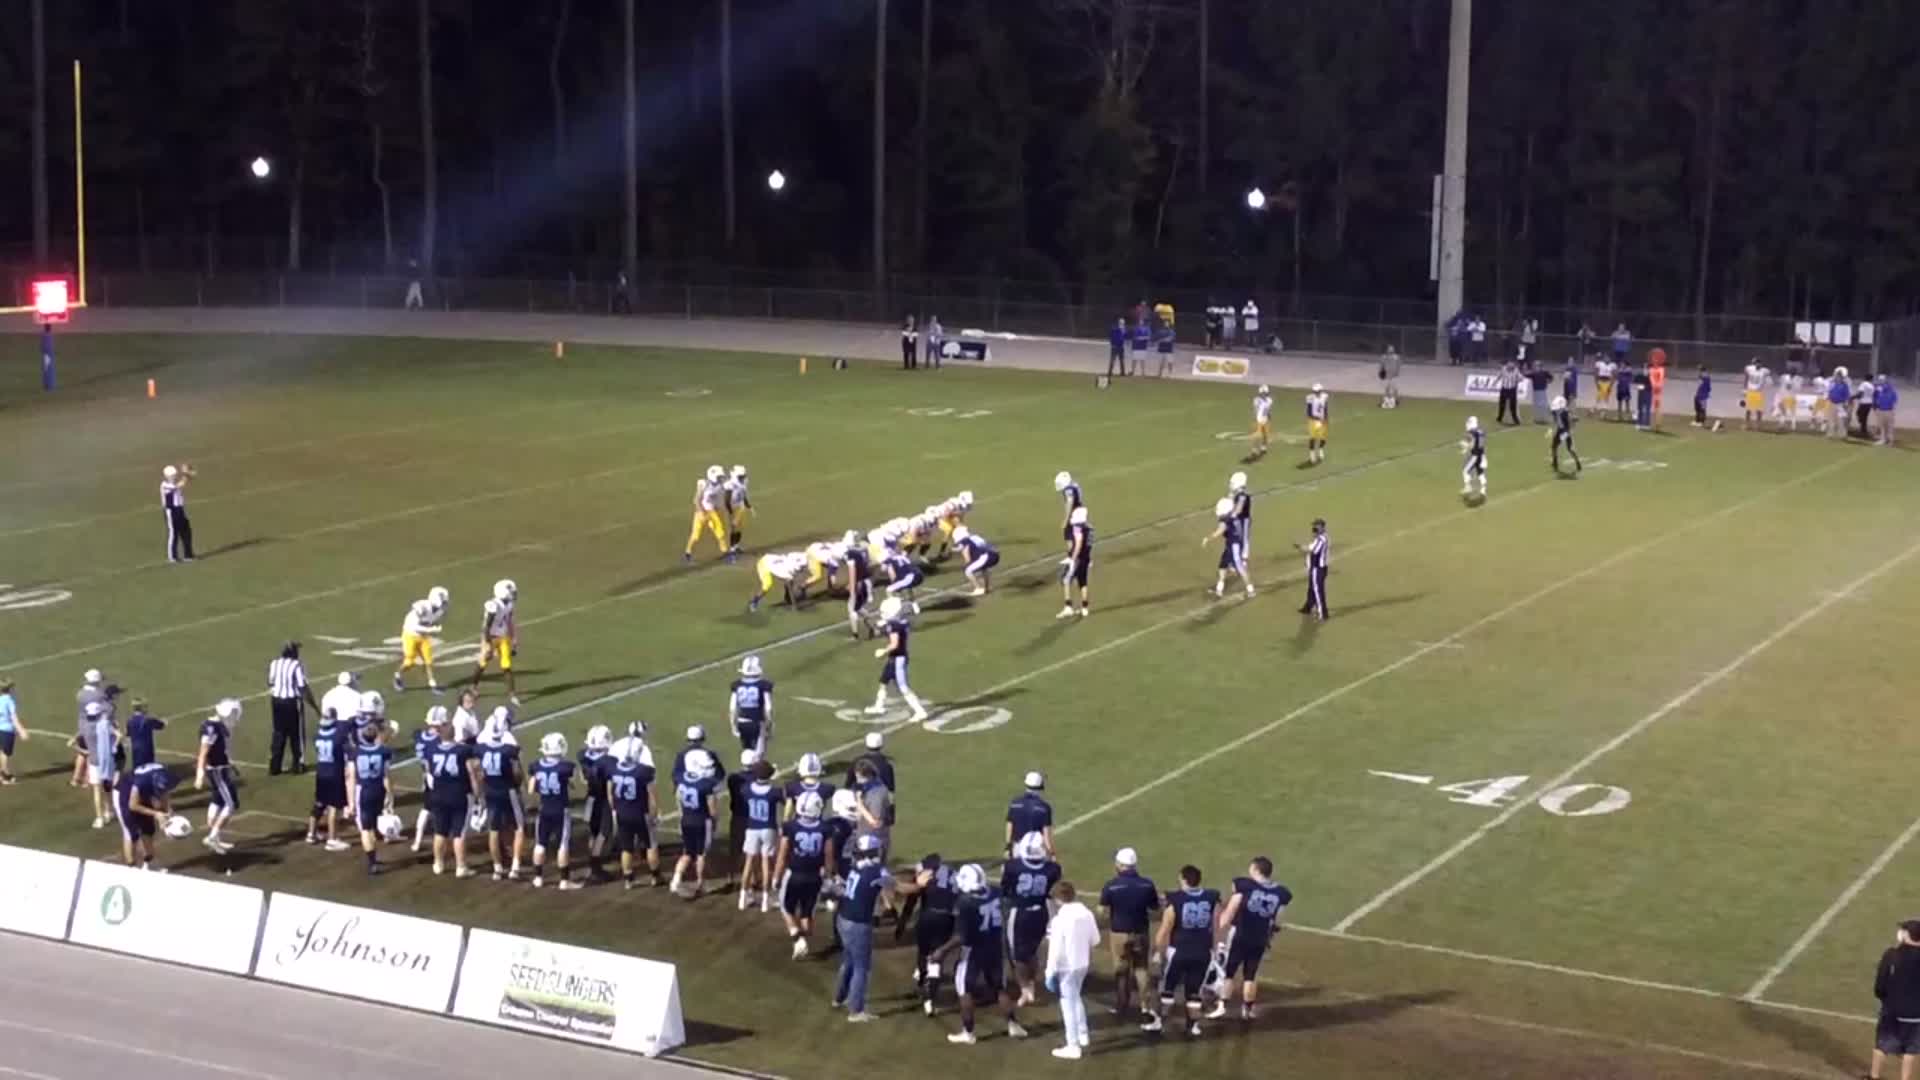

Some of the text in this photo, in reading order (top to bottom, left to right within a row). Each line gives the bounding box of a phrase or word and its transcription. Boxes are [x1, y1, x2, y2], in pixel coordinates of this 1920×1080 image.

[432, 753, 459, 777] 74
[482, 752, 502, 776] 41
[612, 775, 637, 800] 73
[1436, 775, 1632, 816] 40
[748, 799, 770, 822] 10
[275, 910, 431, 973] Johnson
